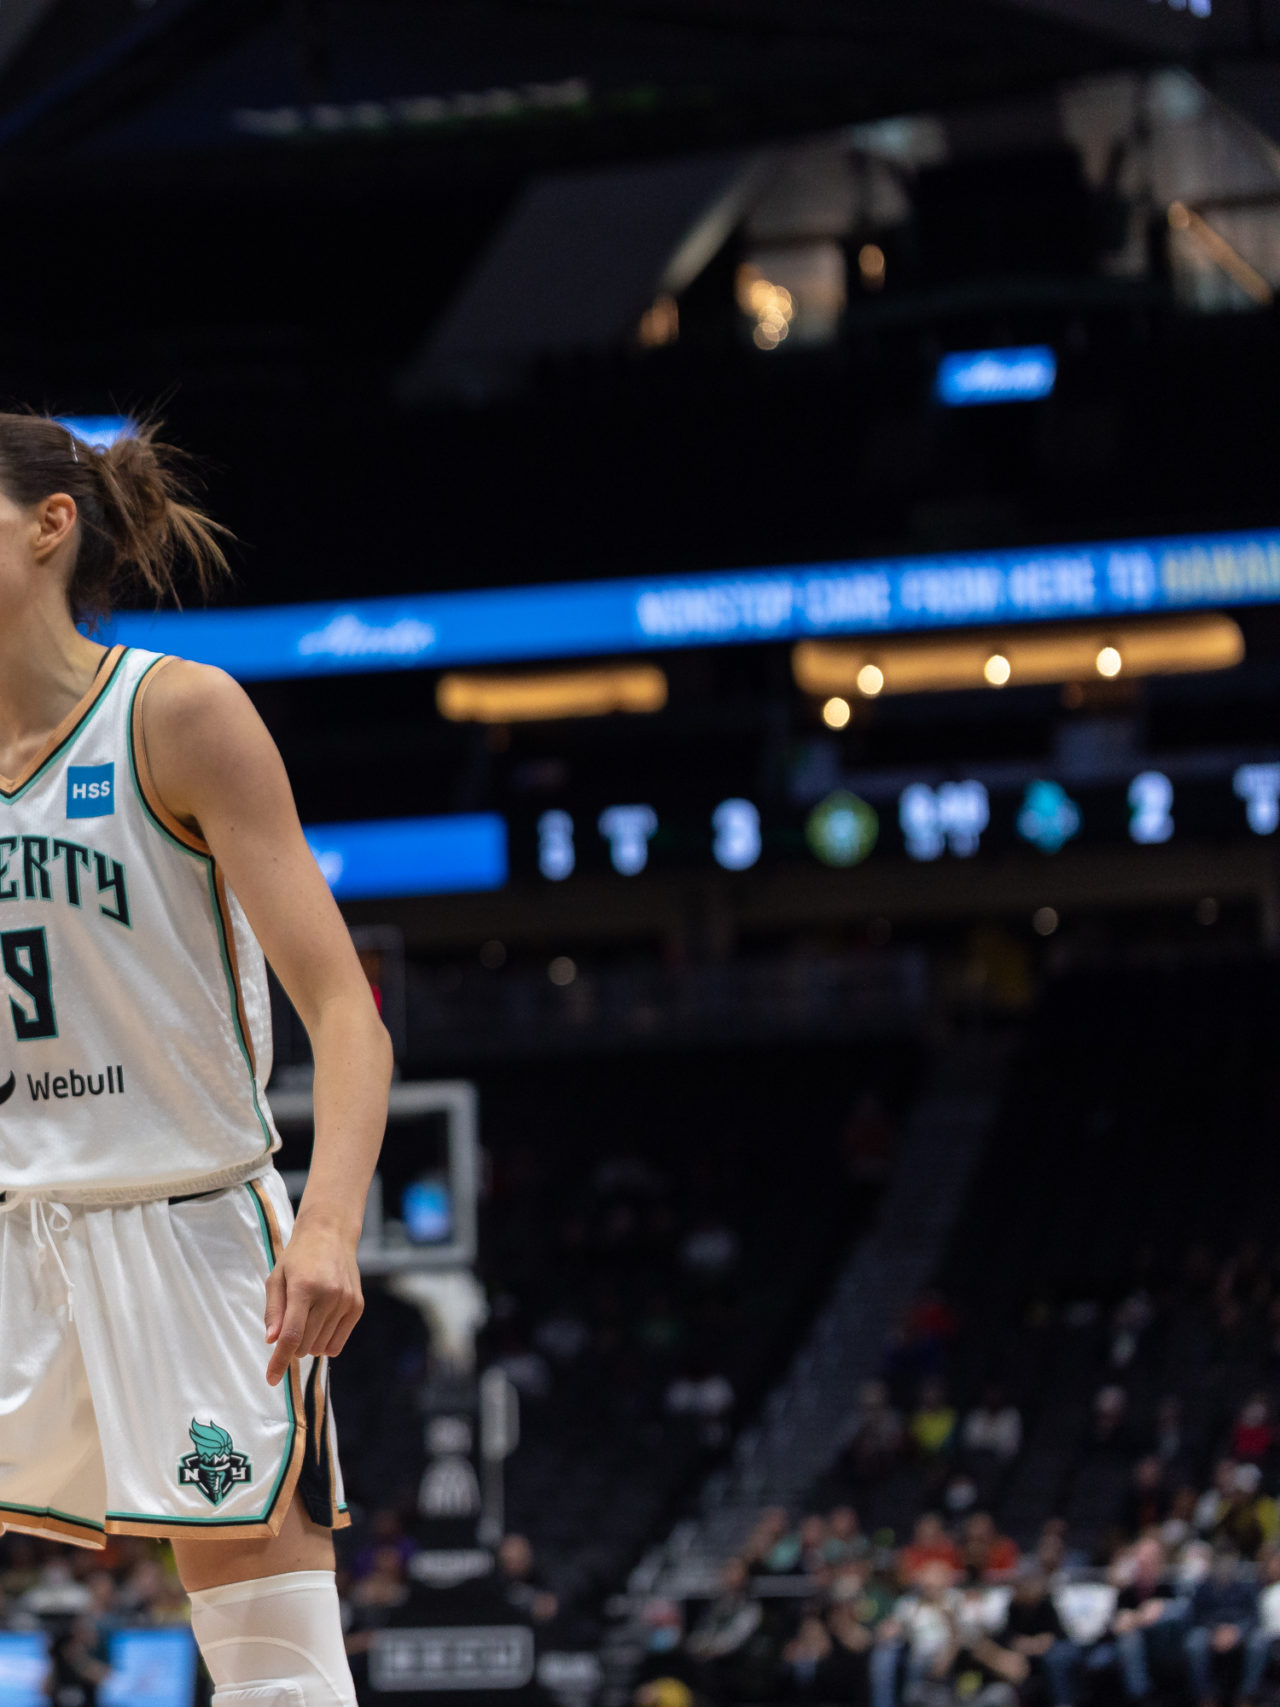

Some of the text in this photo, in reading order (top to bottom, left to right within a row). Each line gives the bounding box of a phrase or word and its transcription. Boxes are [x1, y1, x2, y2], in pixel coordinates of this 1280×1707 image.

[72, 780, 111, 799] HSS
[0, 926, 59, 1042] 9
[27, 1064, 125, 1102] Webull
